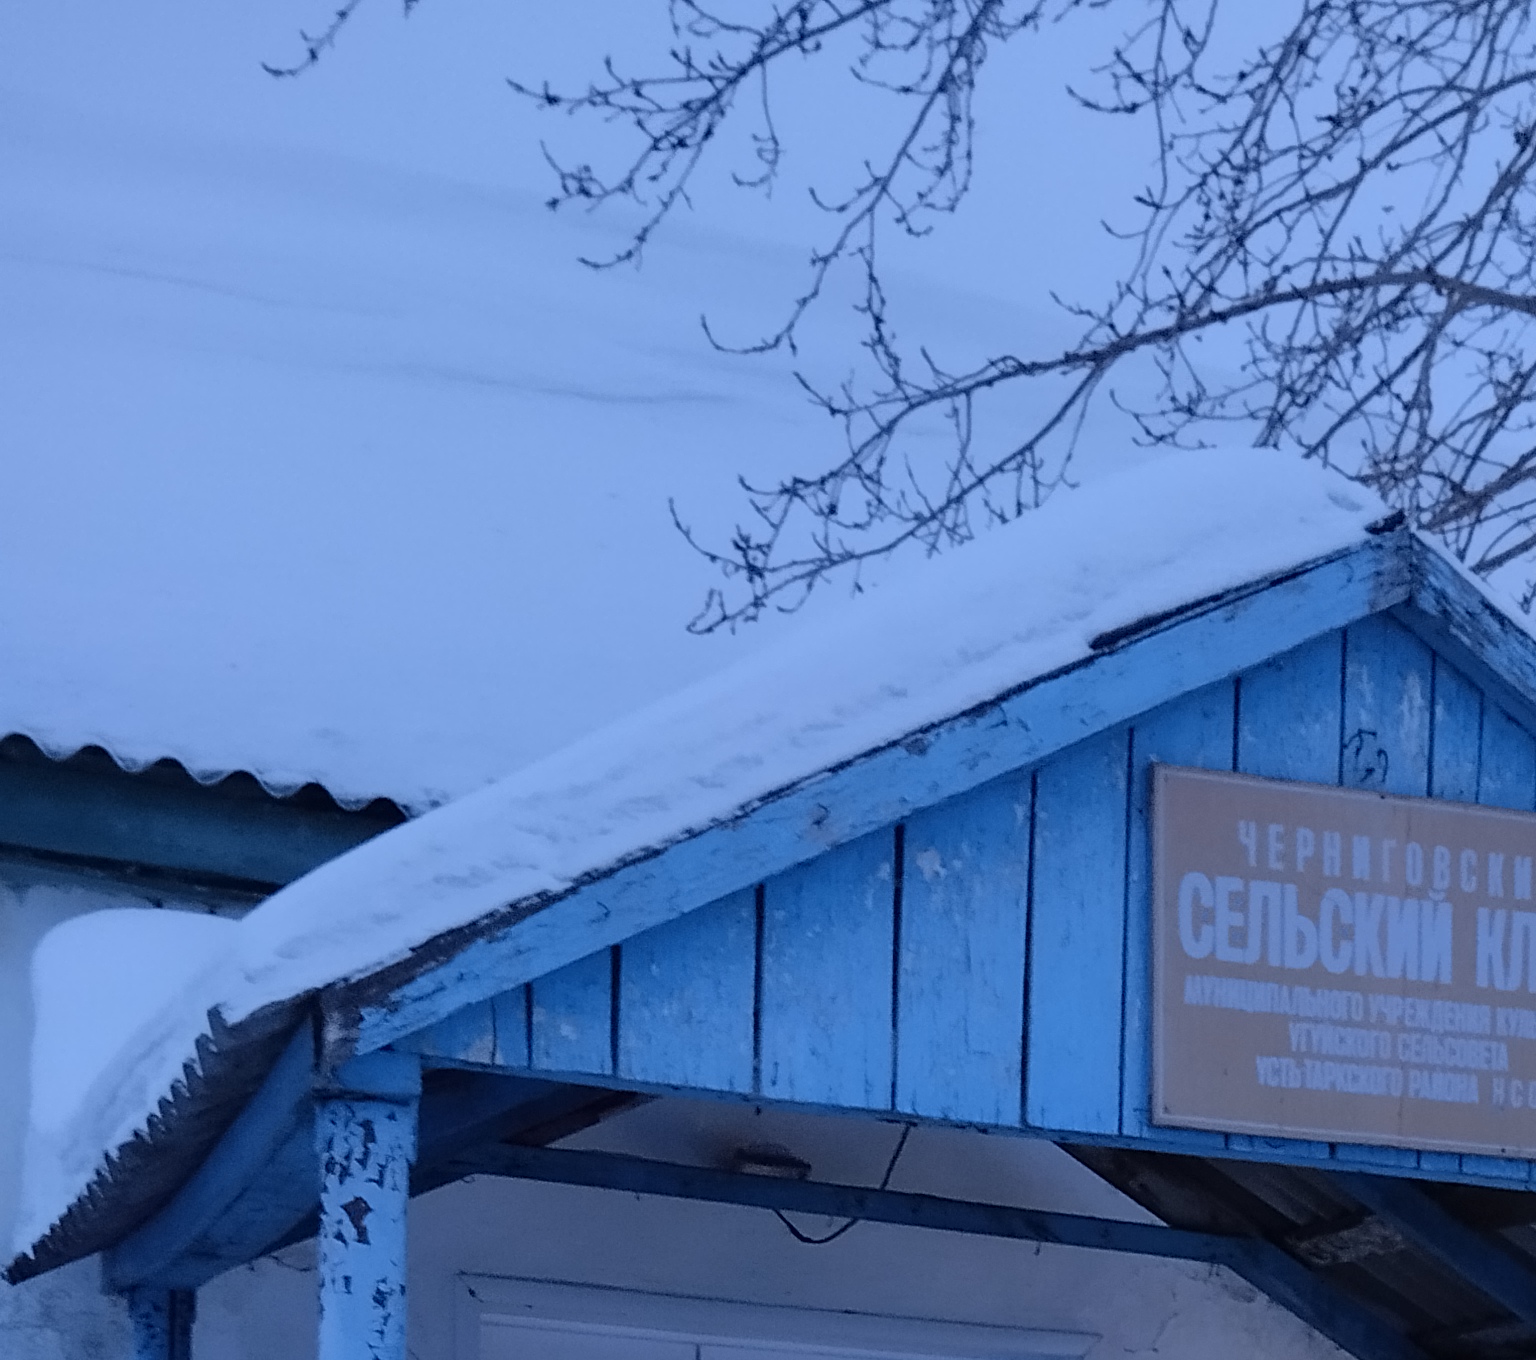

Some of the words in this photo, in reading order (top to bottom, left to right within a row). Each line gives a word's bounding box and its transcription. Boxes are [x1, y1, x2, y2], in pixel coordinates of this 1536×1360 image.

[1178, 871, 1453, 985] СЕЛЬСКИЙ
[1183, 975, 1364, 1022] МУНИЦИПАЛЬНОГО
[1368, 993, 1491, 1036] УЧРЕЖДЕНИЯ
[1398, 1032, 1508, 1072] СЕЛЬСОВЕТА
[1408, 1068, 1479, 1104] РАЙОНА
